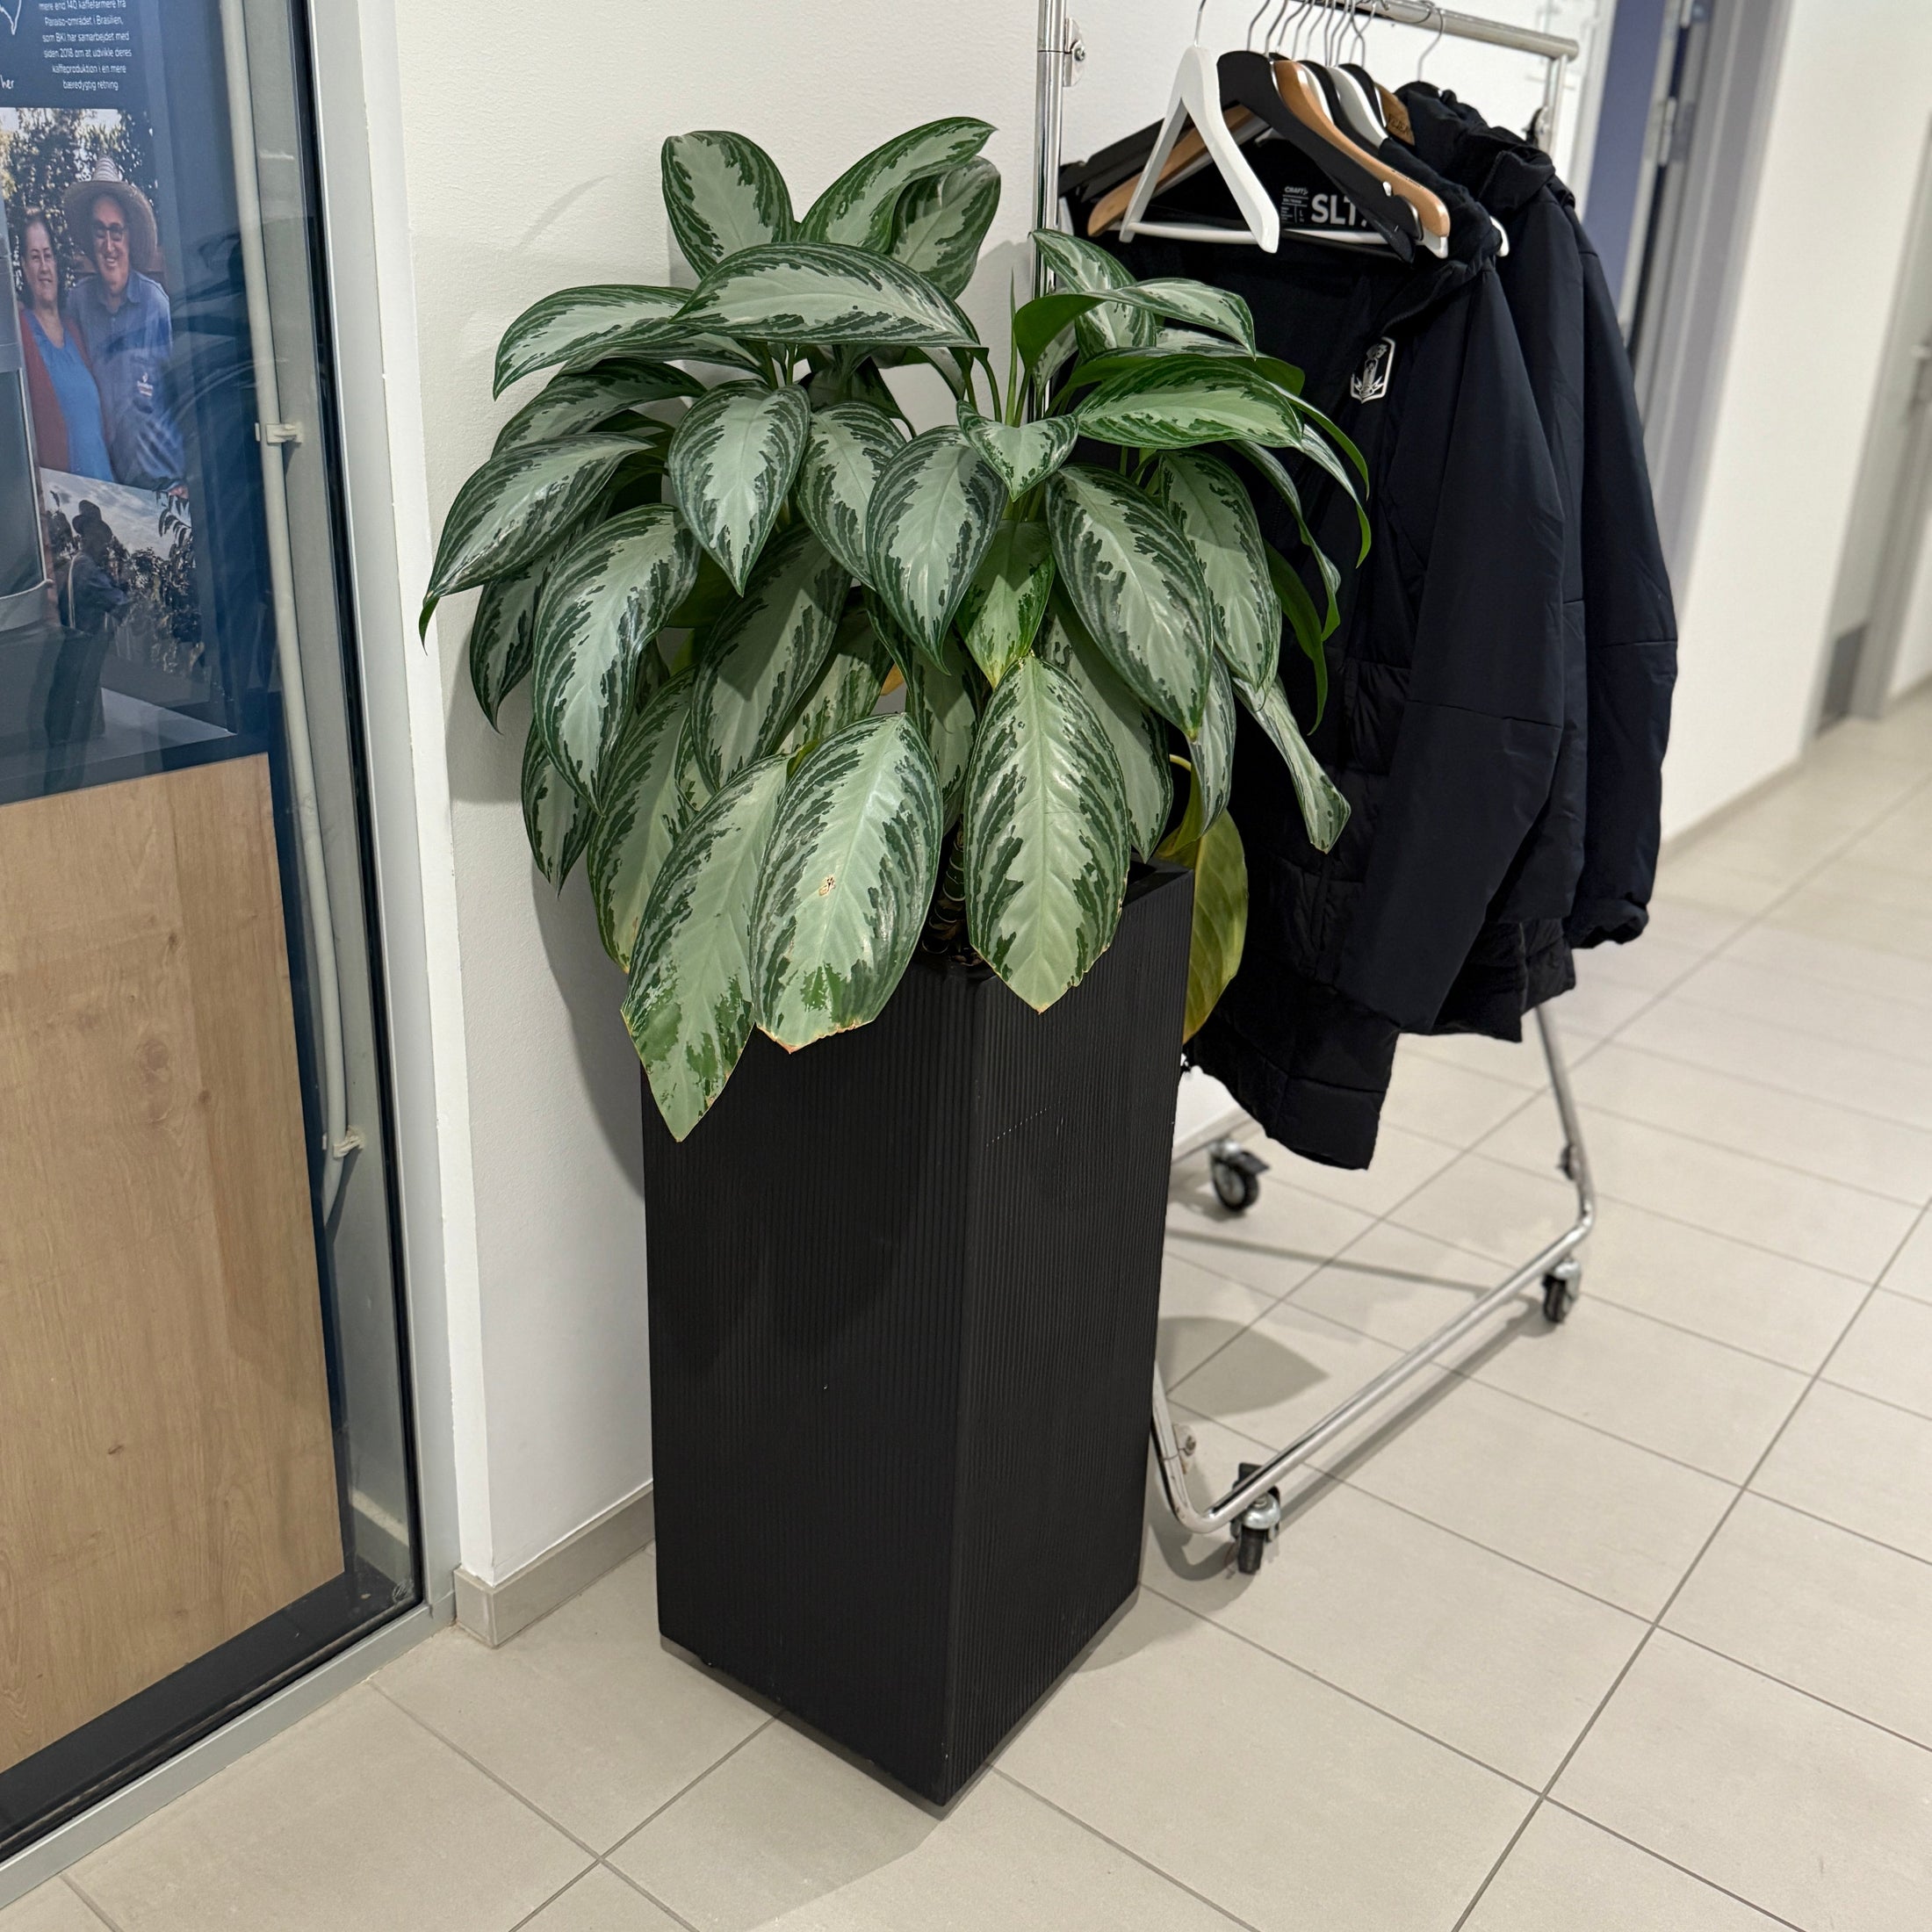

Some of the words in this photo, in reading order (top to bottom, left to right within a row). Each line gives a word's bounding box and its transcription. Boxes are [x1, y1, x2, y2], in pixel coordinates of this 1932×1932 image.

[67, 33, 77, 42] har
[115, 31, 130, 41] med
[44, 48, 59, 58] siden
[75, 49, 84, 58] om
[114, 47, 132, 57] deres
[1310, 193, 1367, 227] SLT
